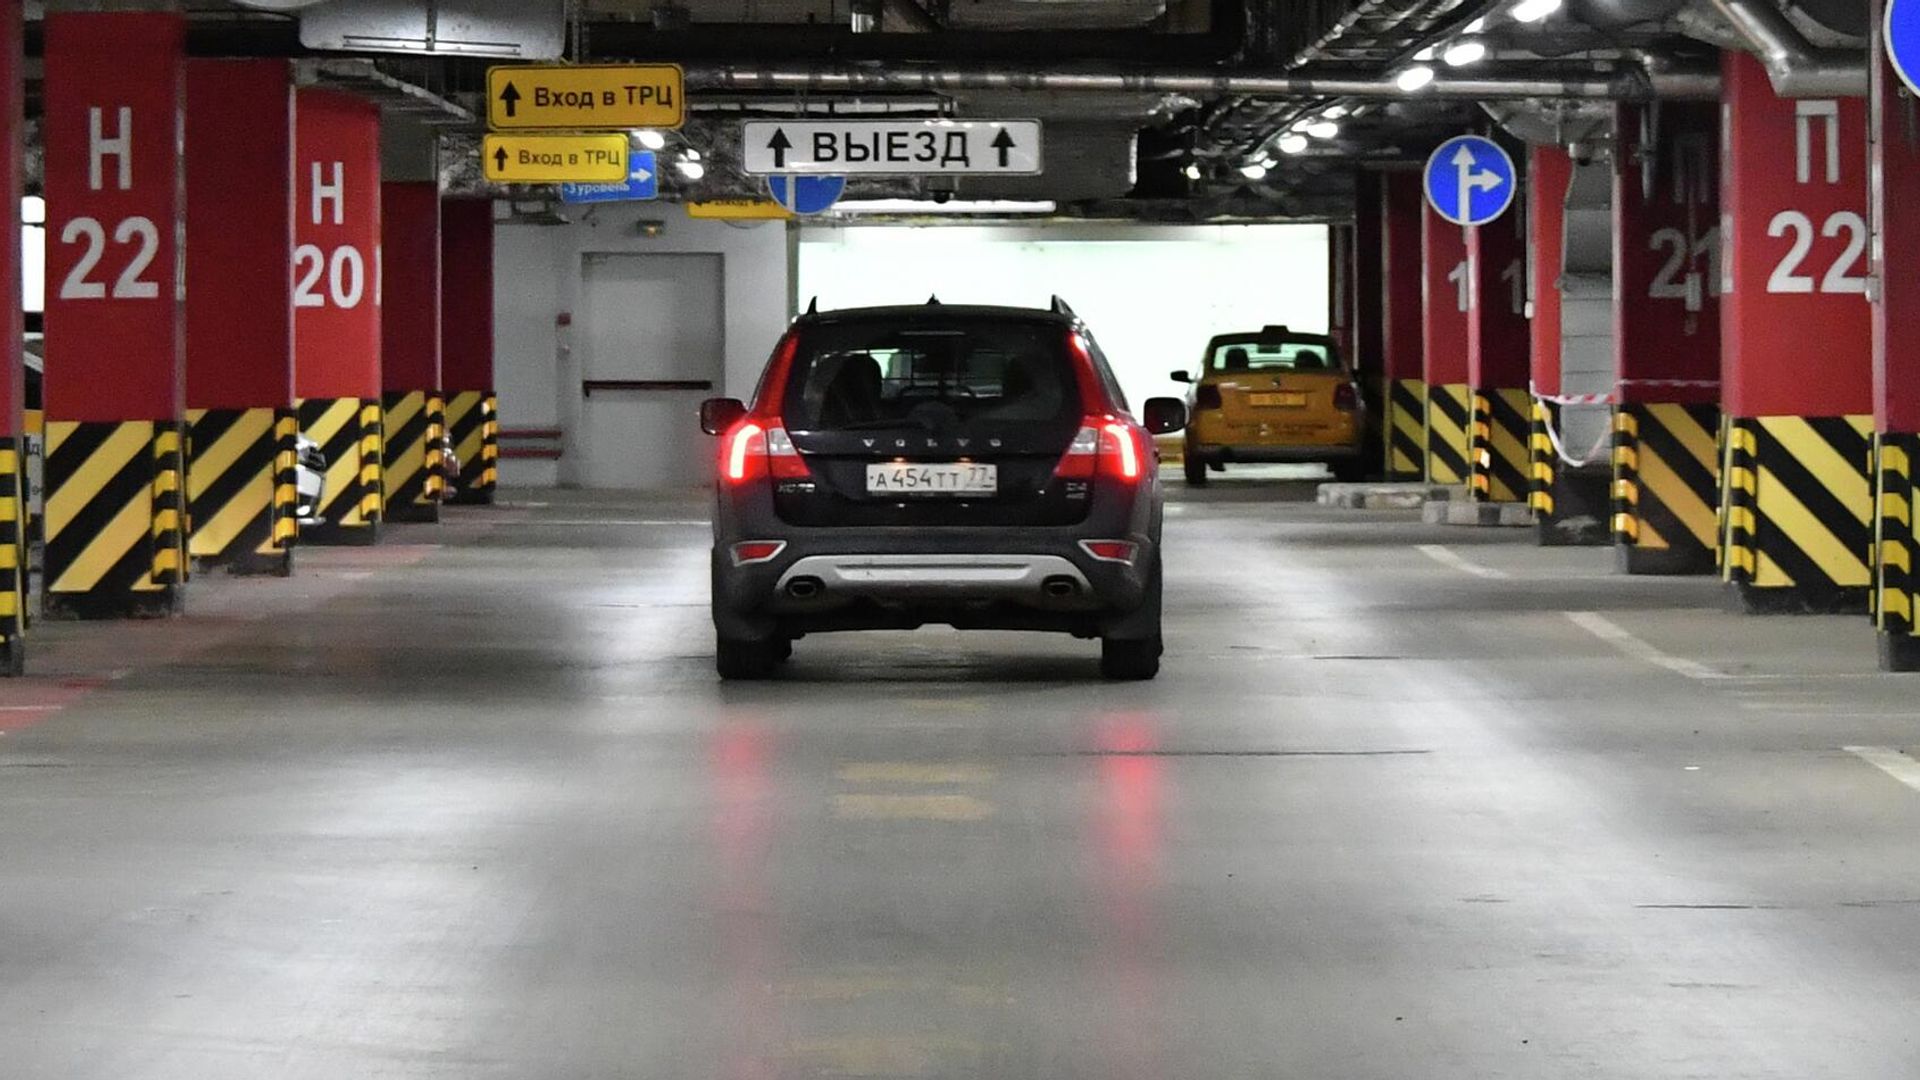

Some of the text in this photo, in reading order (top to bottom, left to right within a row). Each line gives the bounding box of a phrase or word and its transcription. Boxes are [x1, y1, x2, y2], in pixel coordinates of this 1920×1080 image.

[533, 85, 673, 110] Вход в ТРЦ
[89, 106, 132, 190] Н
[518, 150, 621, 166] Вход в ТРЦ
[813, 131, 970, 168] ВЫЕЗД
[1795, 99, 1839, 183] П
[311, 161, 344, 225] Н
[59, 215, 160, 299] 22
[294, 244, 364, 309] 20
[1766, 210, 1867, 293] 22
[862, 438, 1002, 448] VOLVO
[966, 467, 988, 482] 77
